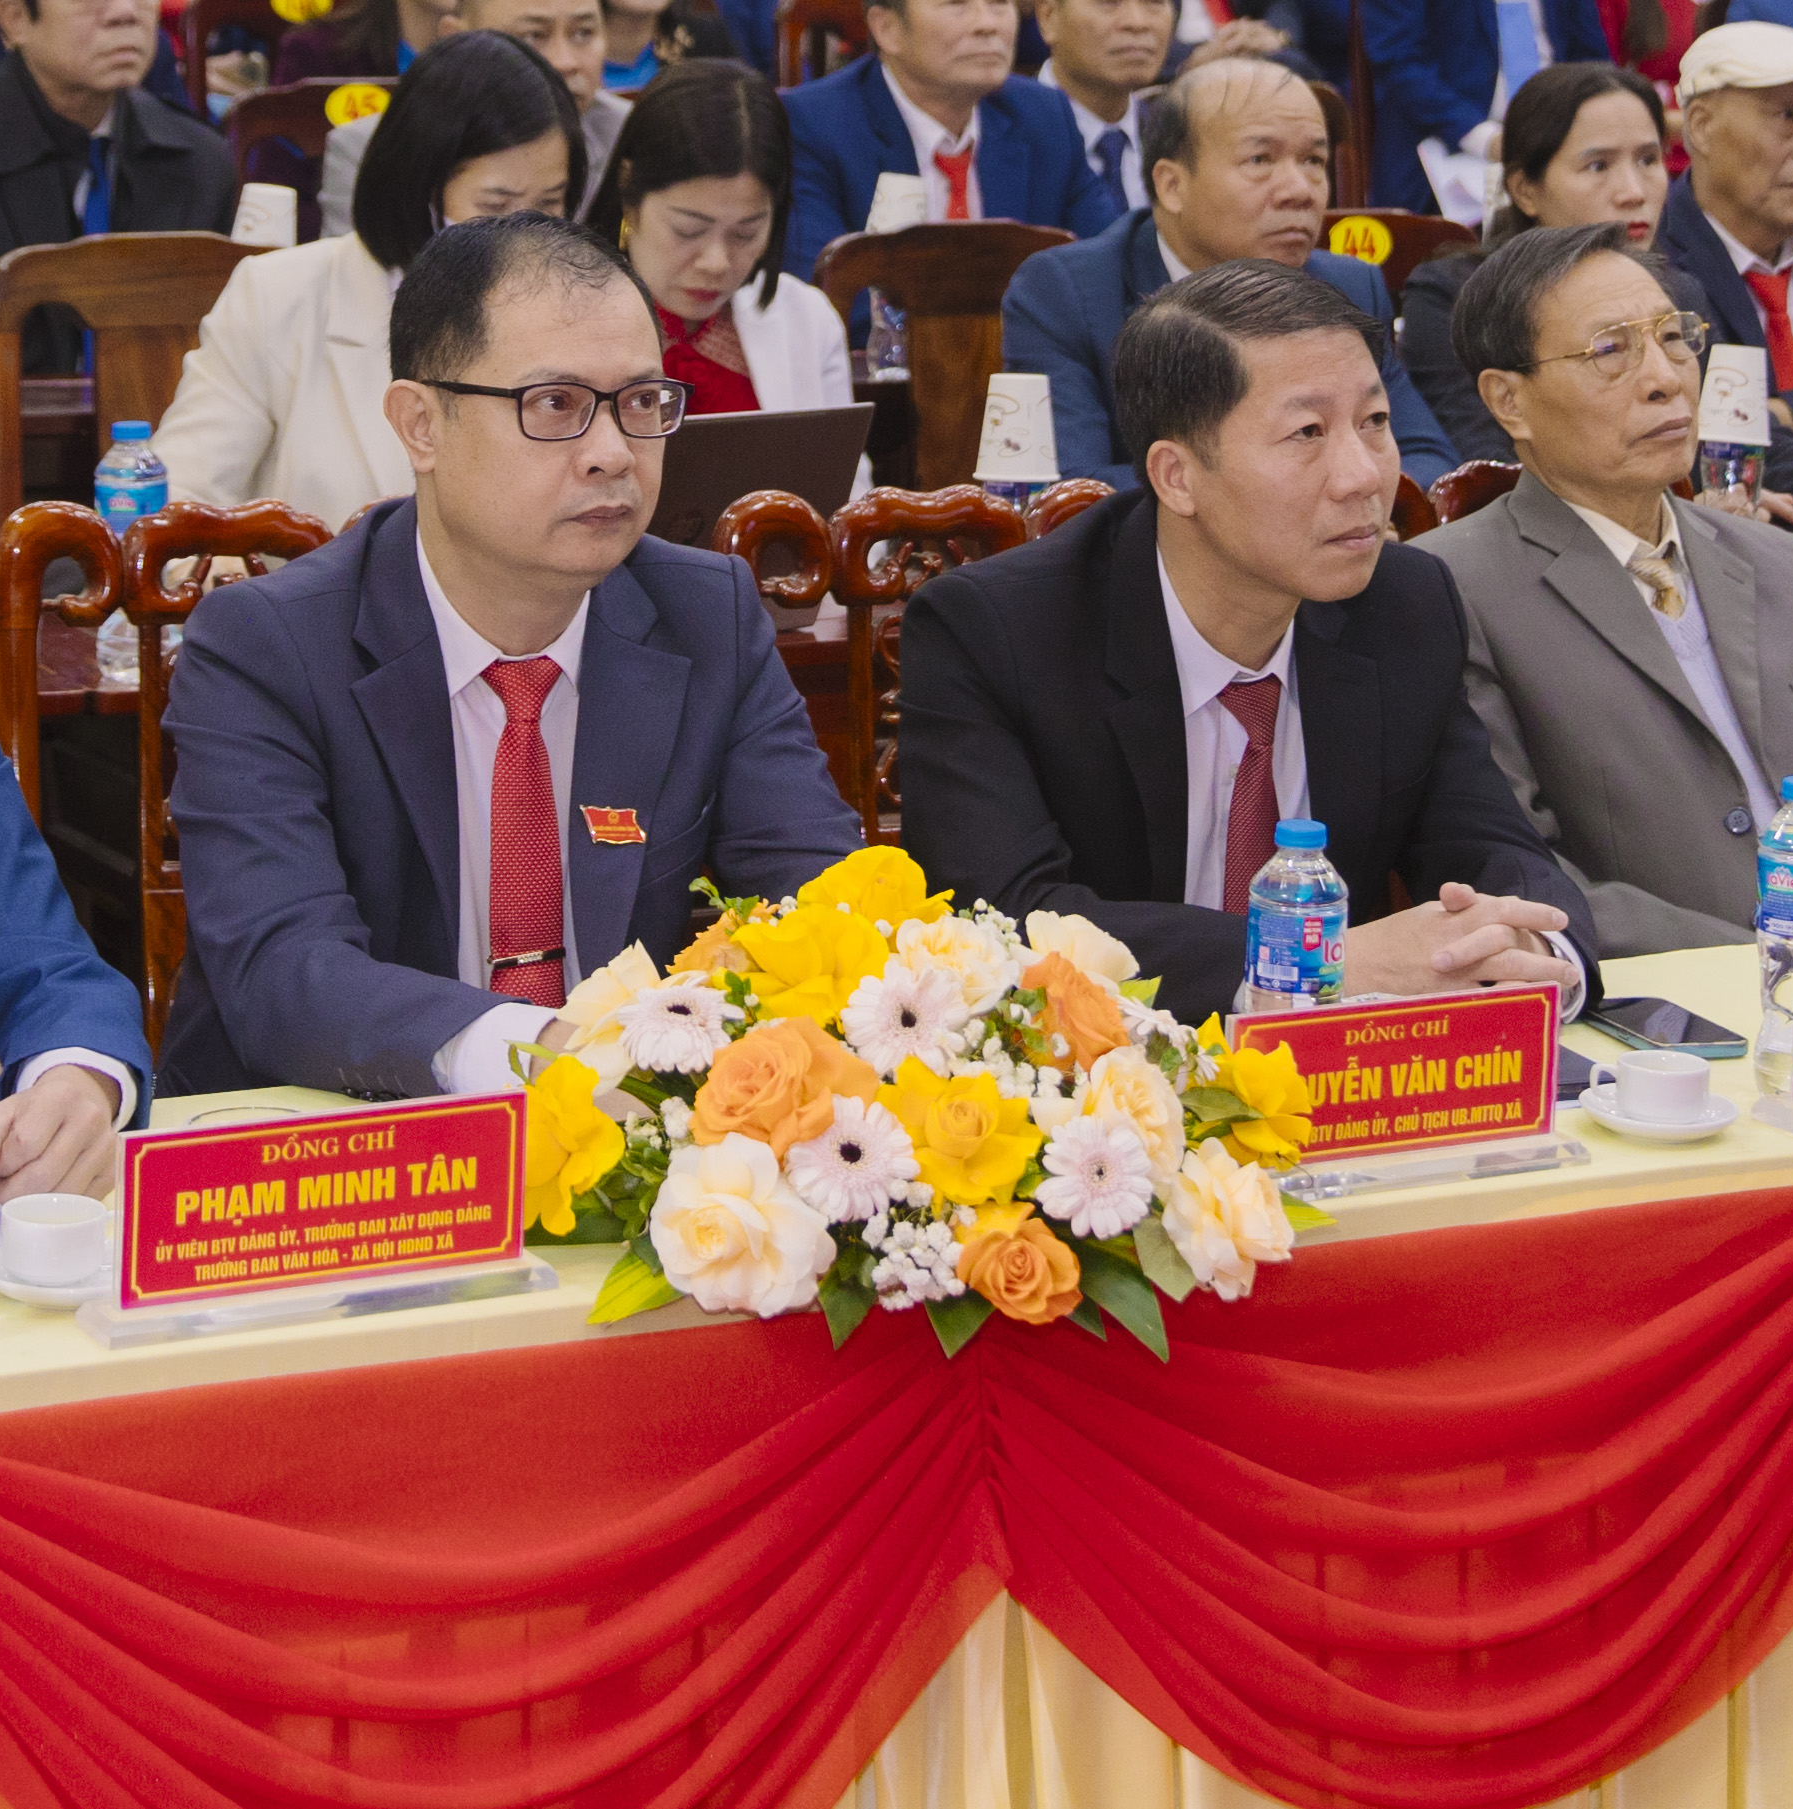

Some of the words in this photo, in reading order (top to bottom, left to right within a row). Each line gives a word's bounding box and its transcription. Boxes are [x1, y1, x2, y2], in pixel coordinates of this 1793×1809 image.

[1343, 226, 1375, 258] 44
[1345, 1021, 1405, 1045] ĐỒNG
[1411, 1016, 1448, 1037] CHÍ
[1390, 1055, 1447, 1097] VĂN
[1455, 1045, 1522, 1090] CHÍN
[262, 1133, 338, 1164] ĐỒNG
[348, 1126, 397, 1152] CHÍ
[176, 1180, 286, 1226] PHẠM
[298, 1166, 396, 1211] MINH
[407, 1154, 477, 1197] TÂN
